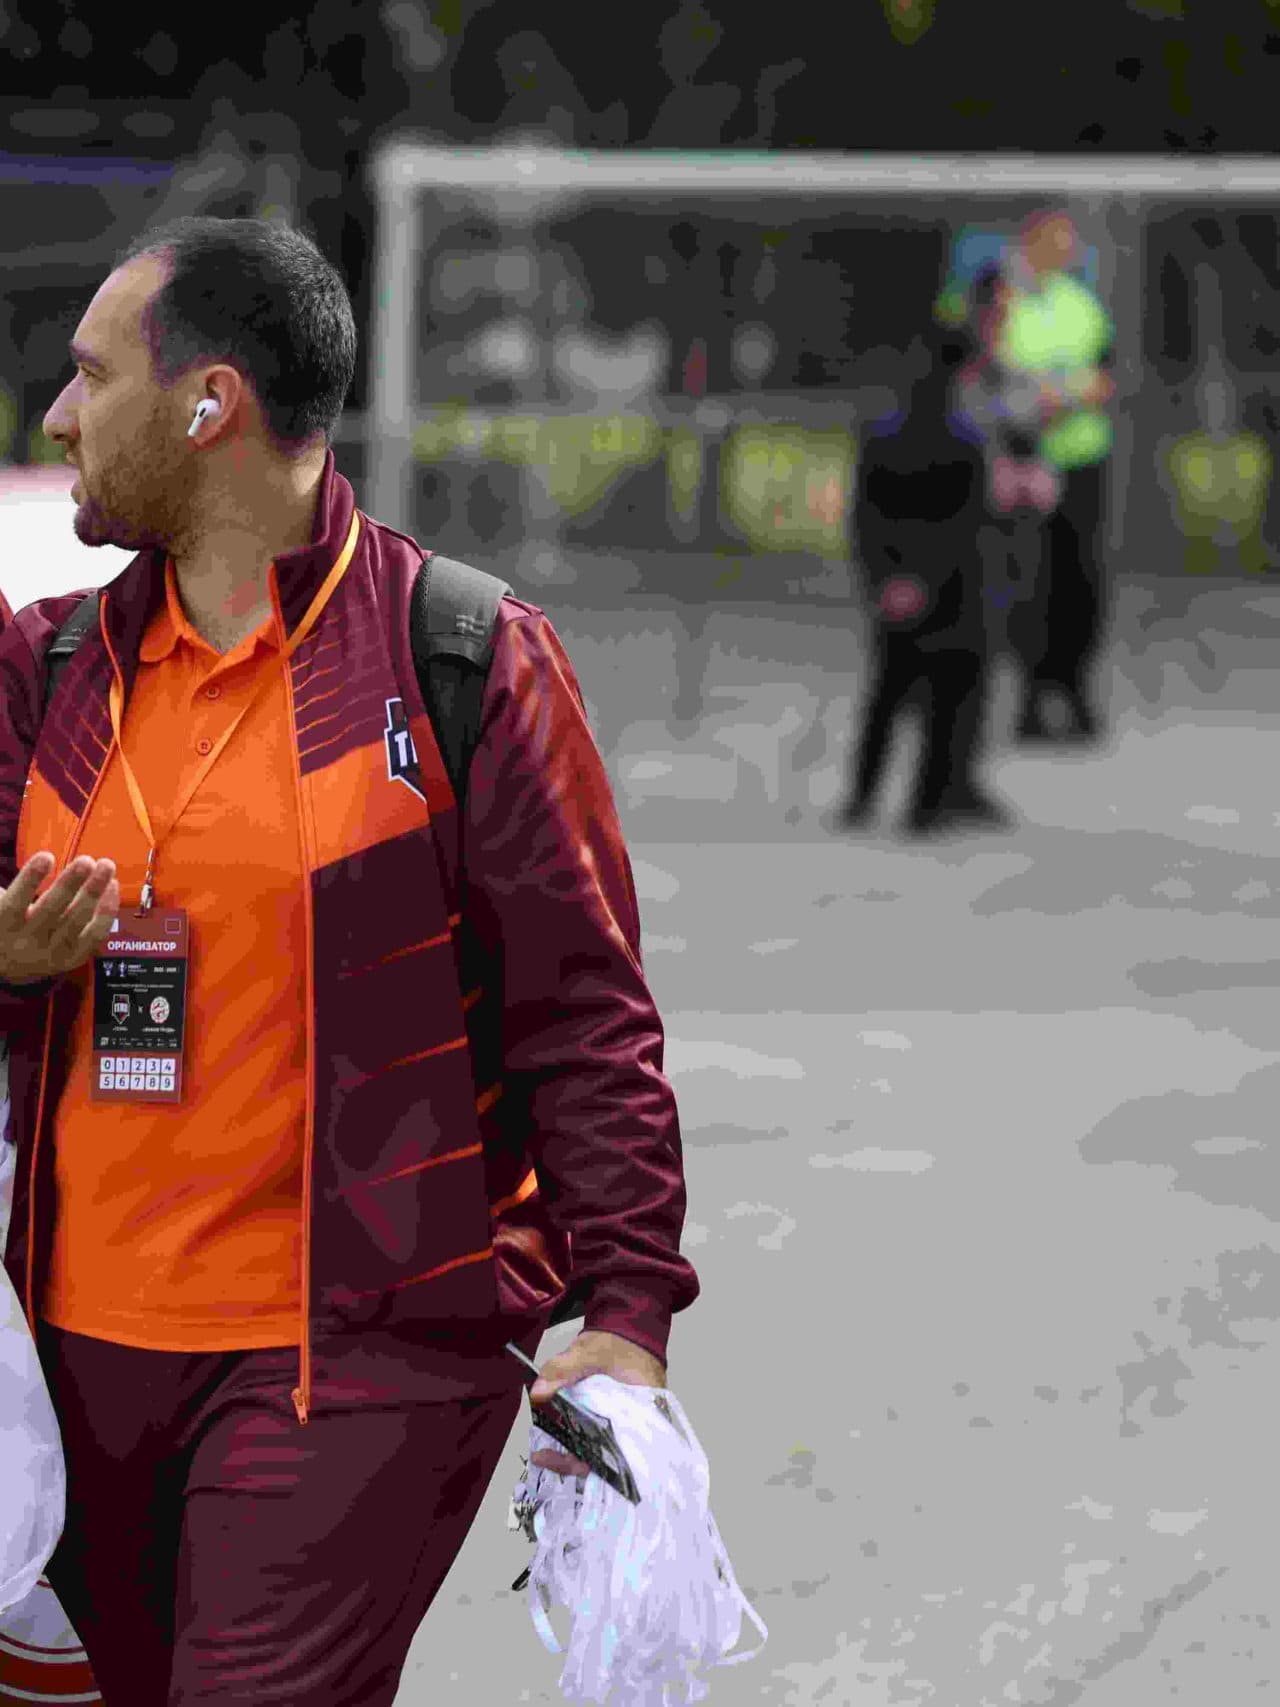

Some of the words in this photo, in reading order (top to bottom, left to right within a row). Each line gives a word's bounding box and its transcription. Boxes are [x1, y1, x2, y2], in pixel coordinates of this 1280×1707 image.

[107, 940, 177, 951] ОРГАНИЗАТОР
[104, 1060, 111, 1070] 0
[121, 1060, 125, 1070] 1
[135, 1061, 142, 1071] 2
[150, 1061, 156, 1071] 3
[104, 1077, 110, 1086] 5
[119, 1077, 125, 1087] 6
[134, 1077, 140, 1087] 7
[149, 1078, 156, 1088] 8
[164, 1078, 170, 1088] 9
